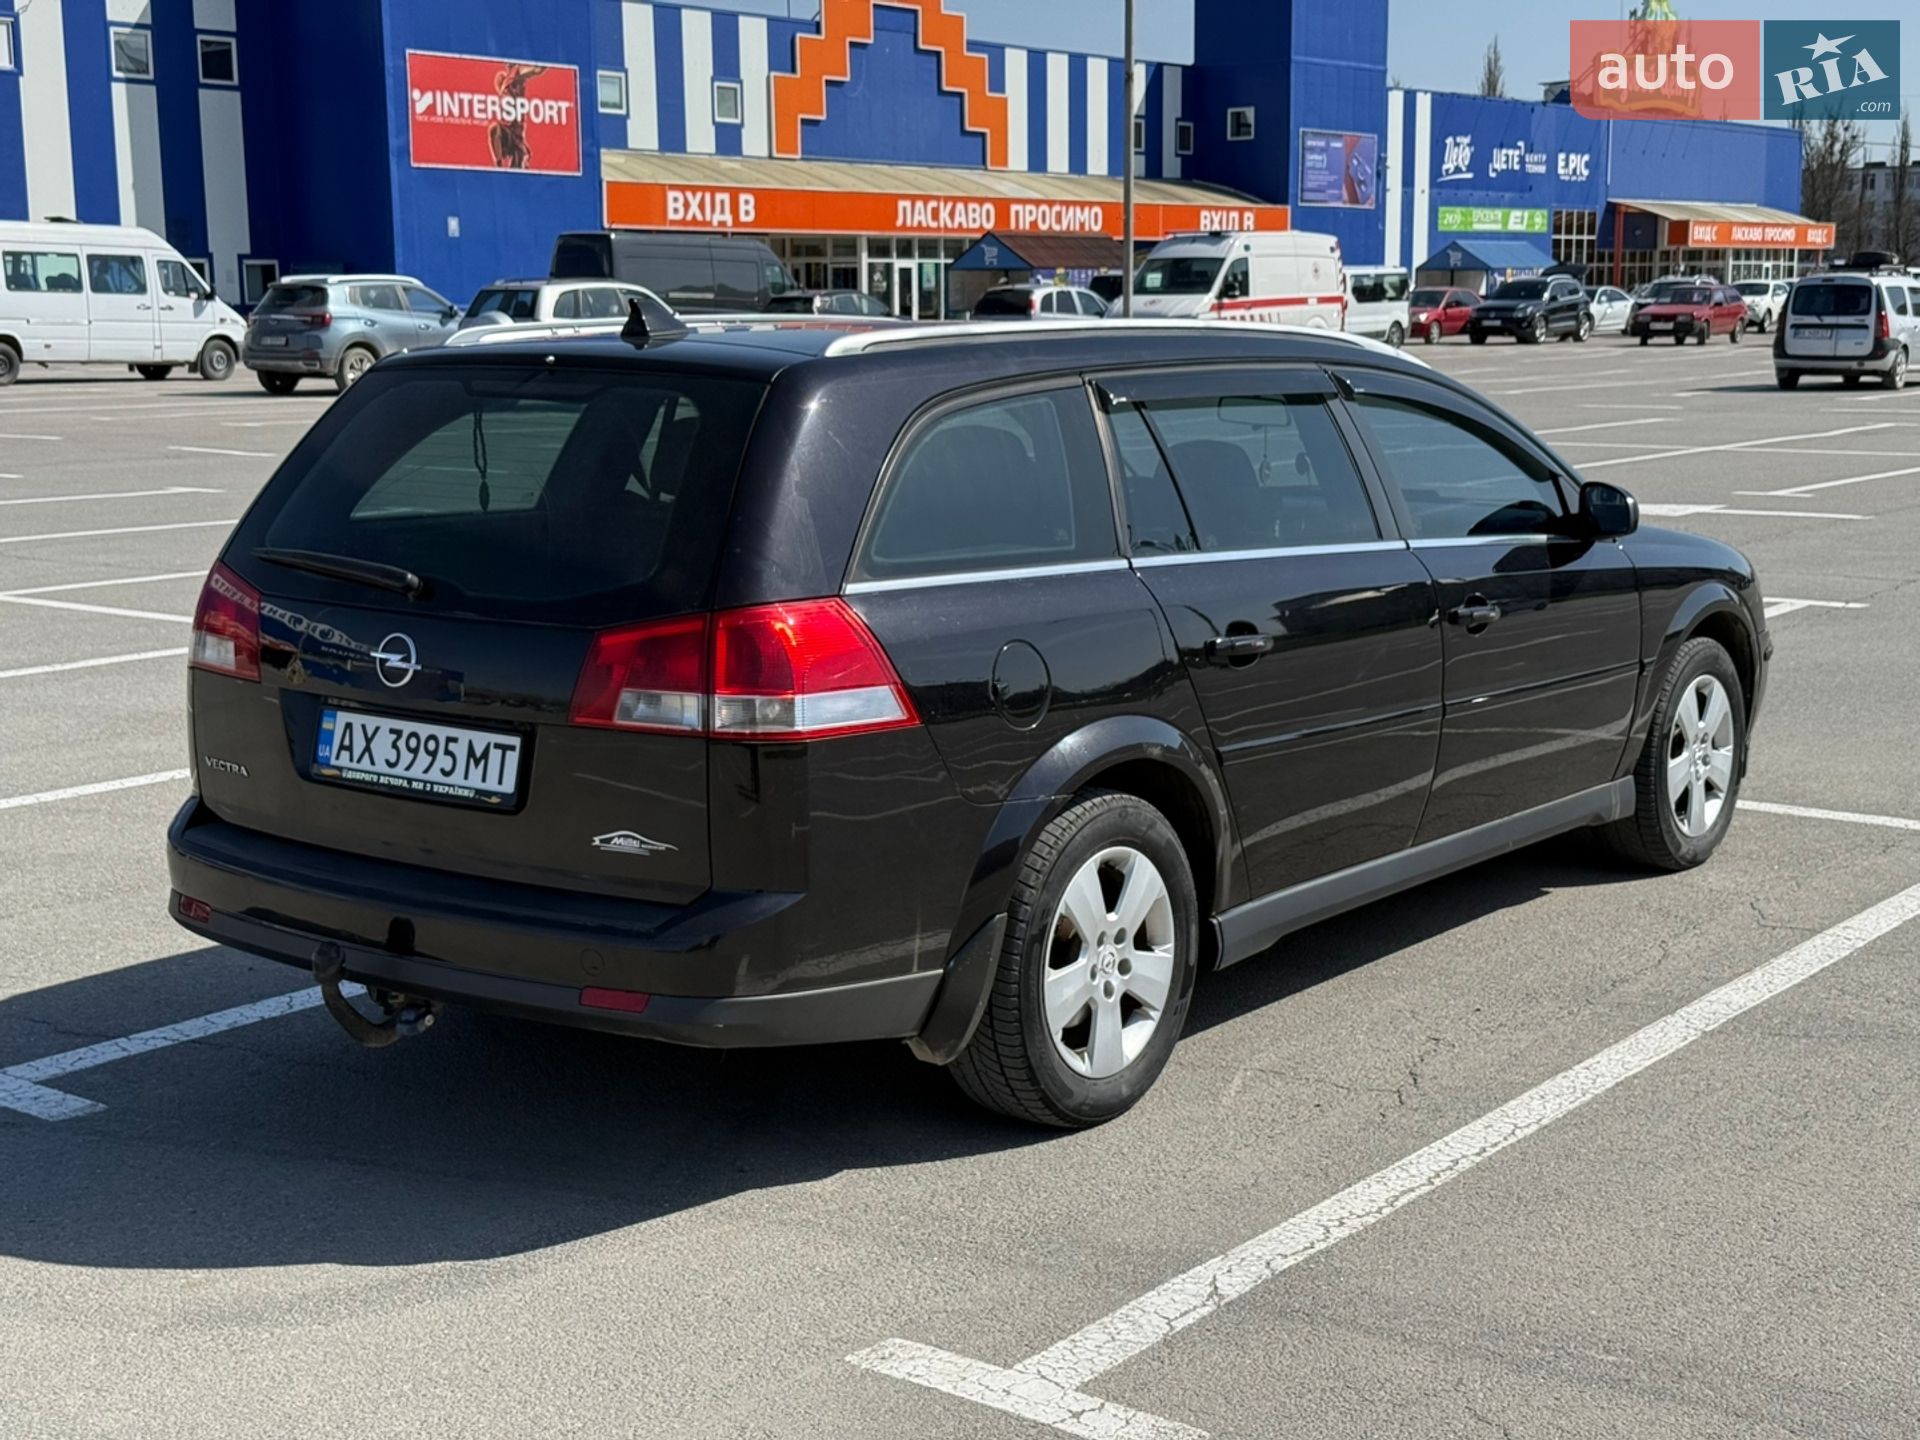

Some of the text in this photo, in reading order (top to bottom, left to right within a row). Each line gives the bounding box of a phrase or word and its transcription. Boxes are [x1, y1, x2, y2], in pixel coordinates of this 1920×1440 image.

[436, 90, 569, 126] INTERSPORT
[667, 190, 756, 227] ВХІД В
[896, 200, 1103, 232] ЛАСКАВО ПРОСИМО
[1693, 225, 1712, 243] ВХІД
[1731, 226, 1796, 243] ЛАСКАВО ПРОСИМО
[318, 743, 330, 758] UA
[335, 722, 517, 786] AX 3995 MT
[205, 755, 248, 777] VECTRA
